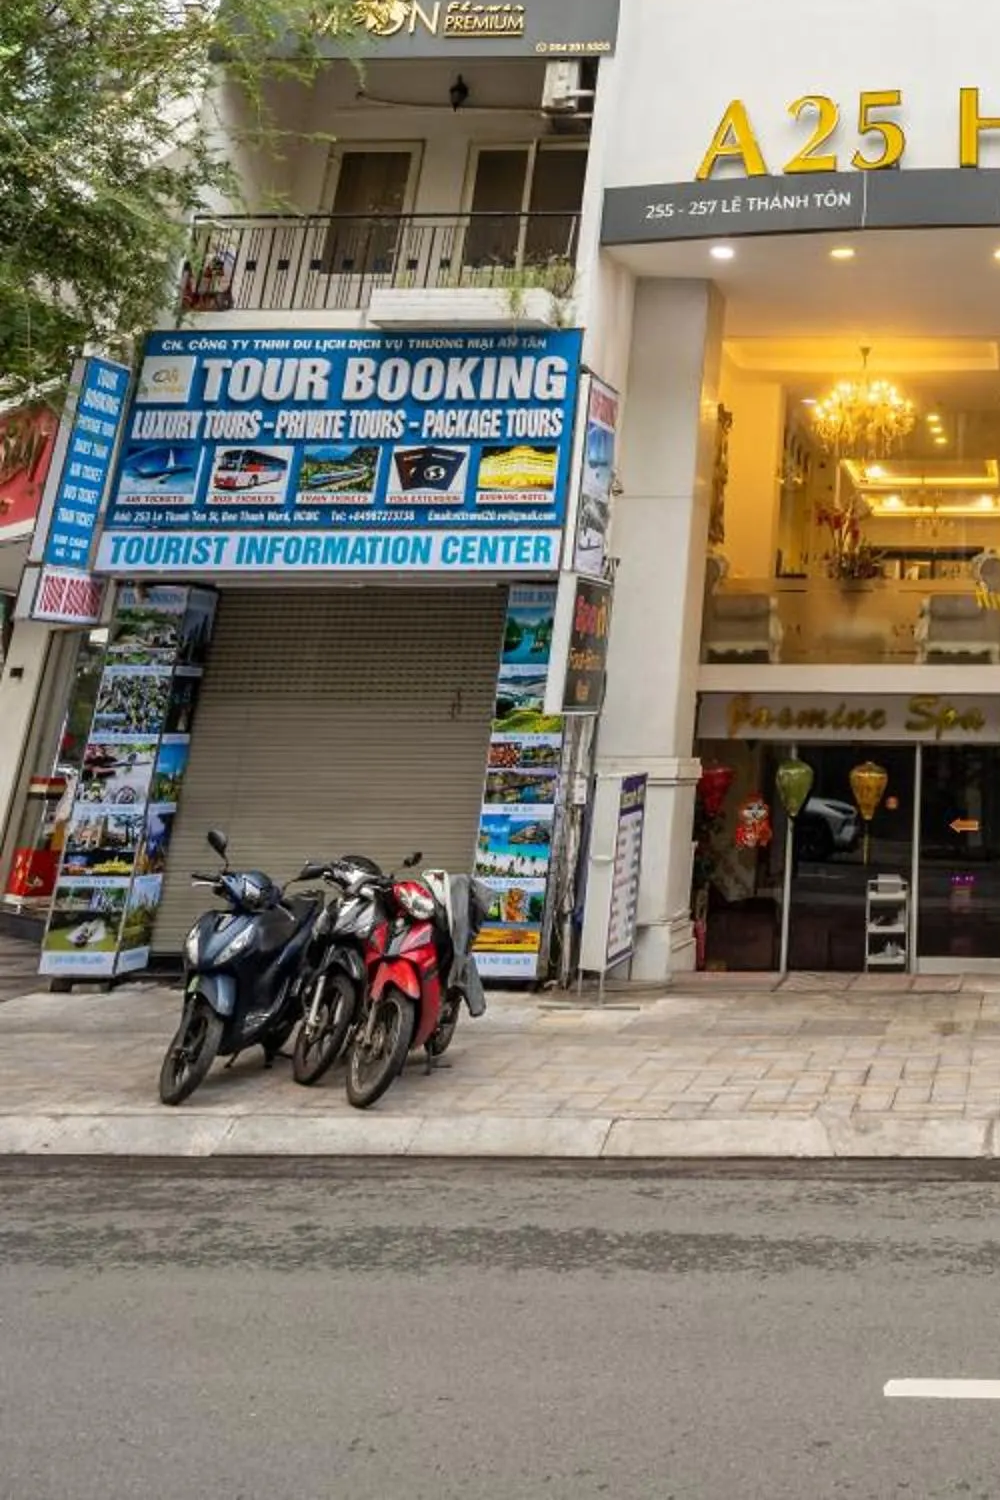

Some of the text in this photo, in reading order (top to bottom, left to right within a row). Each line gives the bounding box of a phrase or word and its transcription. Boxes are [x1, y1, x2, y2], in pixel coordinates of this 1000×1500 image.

[444, 15, 524, 30] PREMIUM
[695, 89, 906, 181] A25
[645, 204, 674, 219] 255
[688, 201, 716, 216] 257
[814, 191, 851, 206] TÔN
[232, 339, 249, 350] TY
[253, 339, 289, 350] TNHH
[293, 339, 312, 349] DU
[203, 357, 332, 401] TOUR
[342, 355, 569, 401] BOOKING
[131, 410, 203, 439] LUXURY
[203, 409, 263, 439] TOURS
[274, 409, 347, 439] PRIVATE
[349, 409, 406, 439] TOURS
[421, 409, 503, 439] PACKAGE
[506, 408, 564, 438] TOURS
[110, 535, 553, 565] TOURIST INFORMATION CENTER
[726, 693, 986, 740] Jasmine Spa
